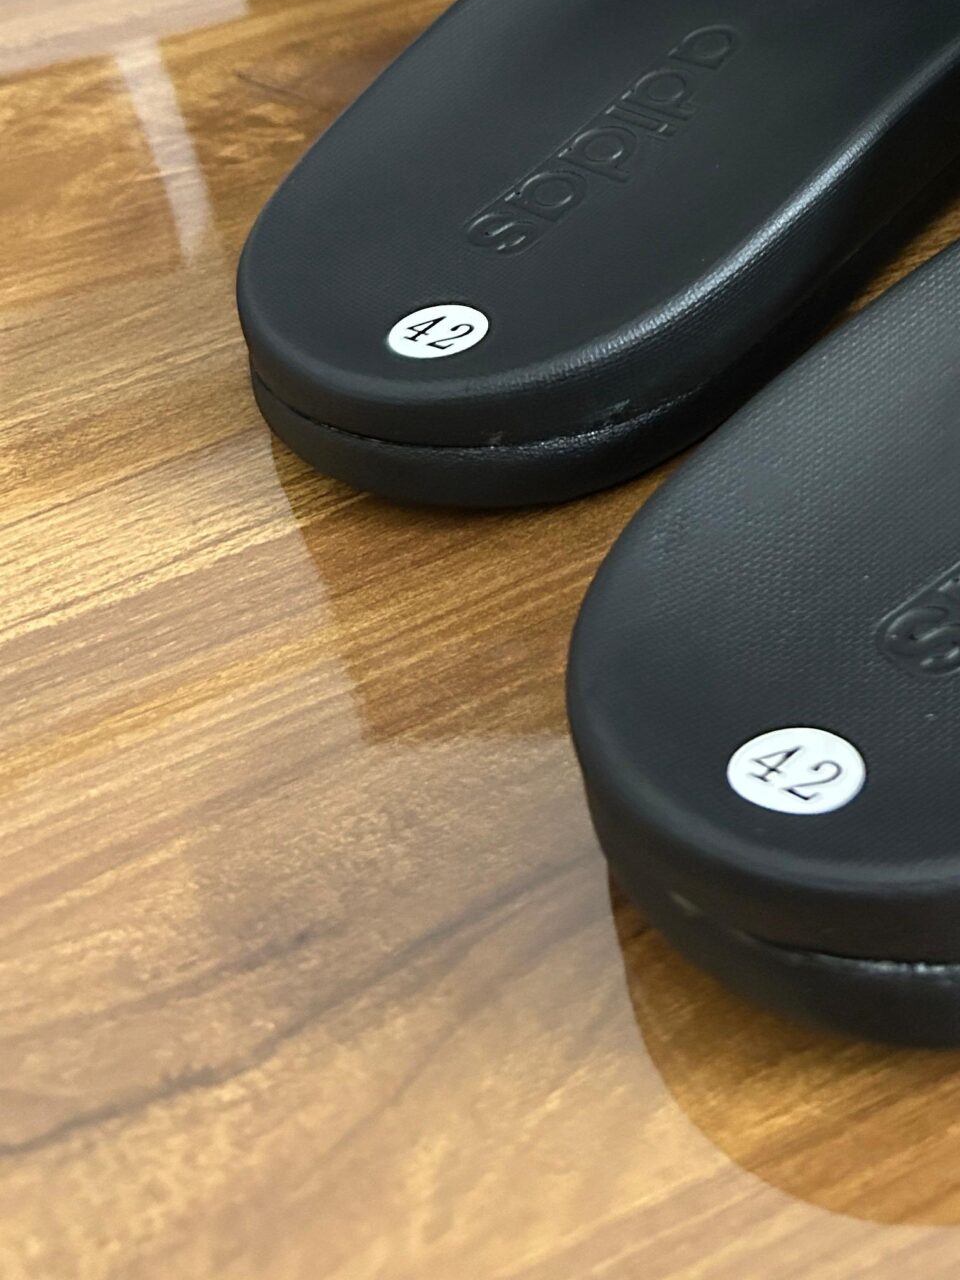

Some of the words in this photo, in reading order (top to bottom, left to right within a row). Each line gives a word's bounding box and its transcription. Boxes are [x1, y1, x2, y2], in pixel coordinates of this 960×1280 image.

[466, 23, 742, 255] adidas
[403, 315, 475, 350] 42
[747, 745, 843, 801] 42
